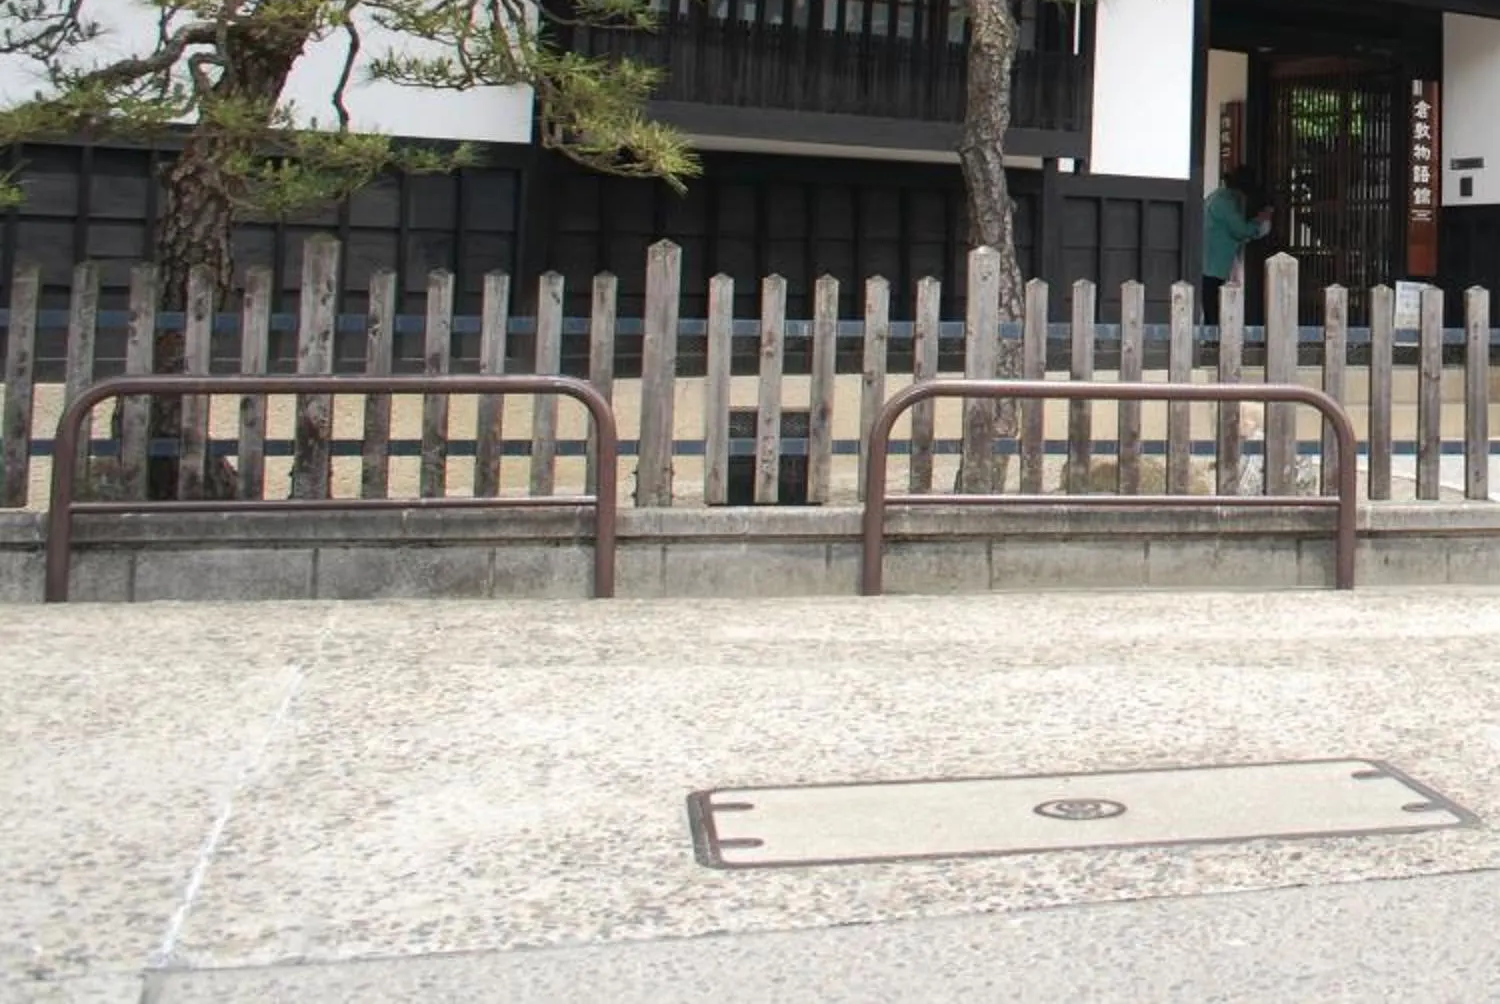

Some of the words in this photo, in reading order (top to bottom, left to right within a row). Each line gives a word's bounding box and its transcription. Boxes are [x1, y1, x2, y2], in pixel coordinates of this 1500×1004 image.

[1413, 100, 1432, 205] 倉敷物語館
